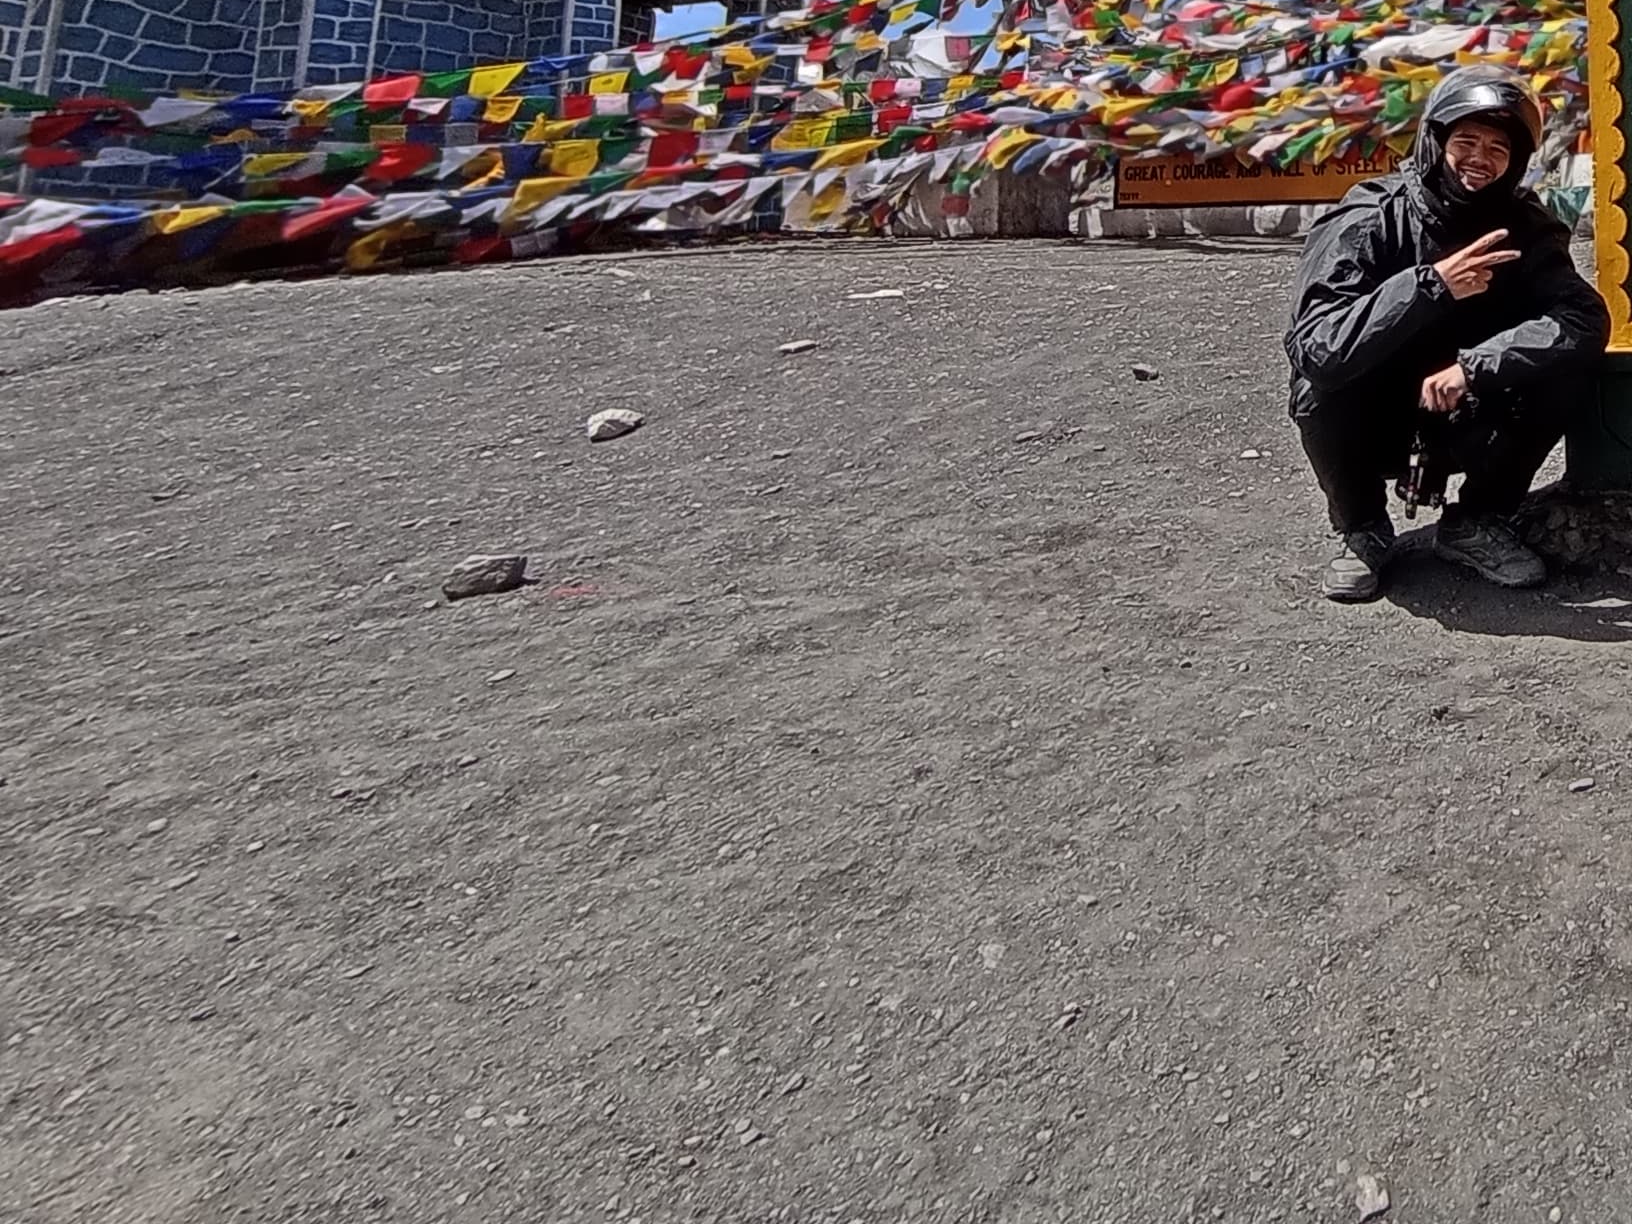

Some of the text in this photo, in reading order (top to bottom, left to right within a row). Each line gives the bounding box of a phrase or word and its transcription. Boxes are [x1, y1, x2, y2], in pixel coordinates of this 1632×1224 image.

[1124, 164, 1166, 182] GREAT
[1172, 161, 1232, 181] COURAGE
[1335, 158, 1384, 176] STEEL
